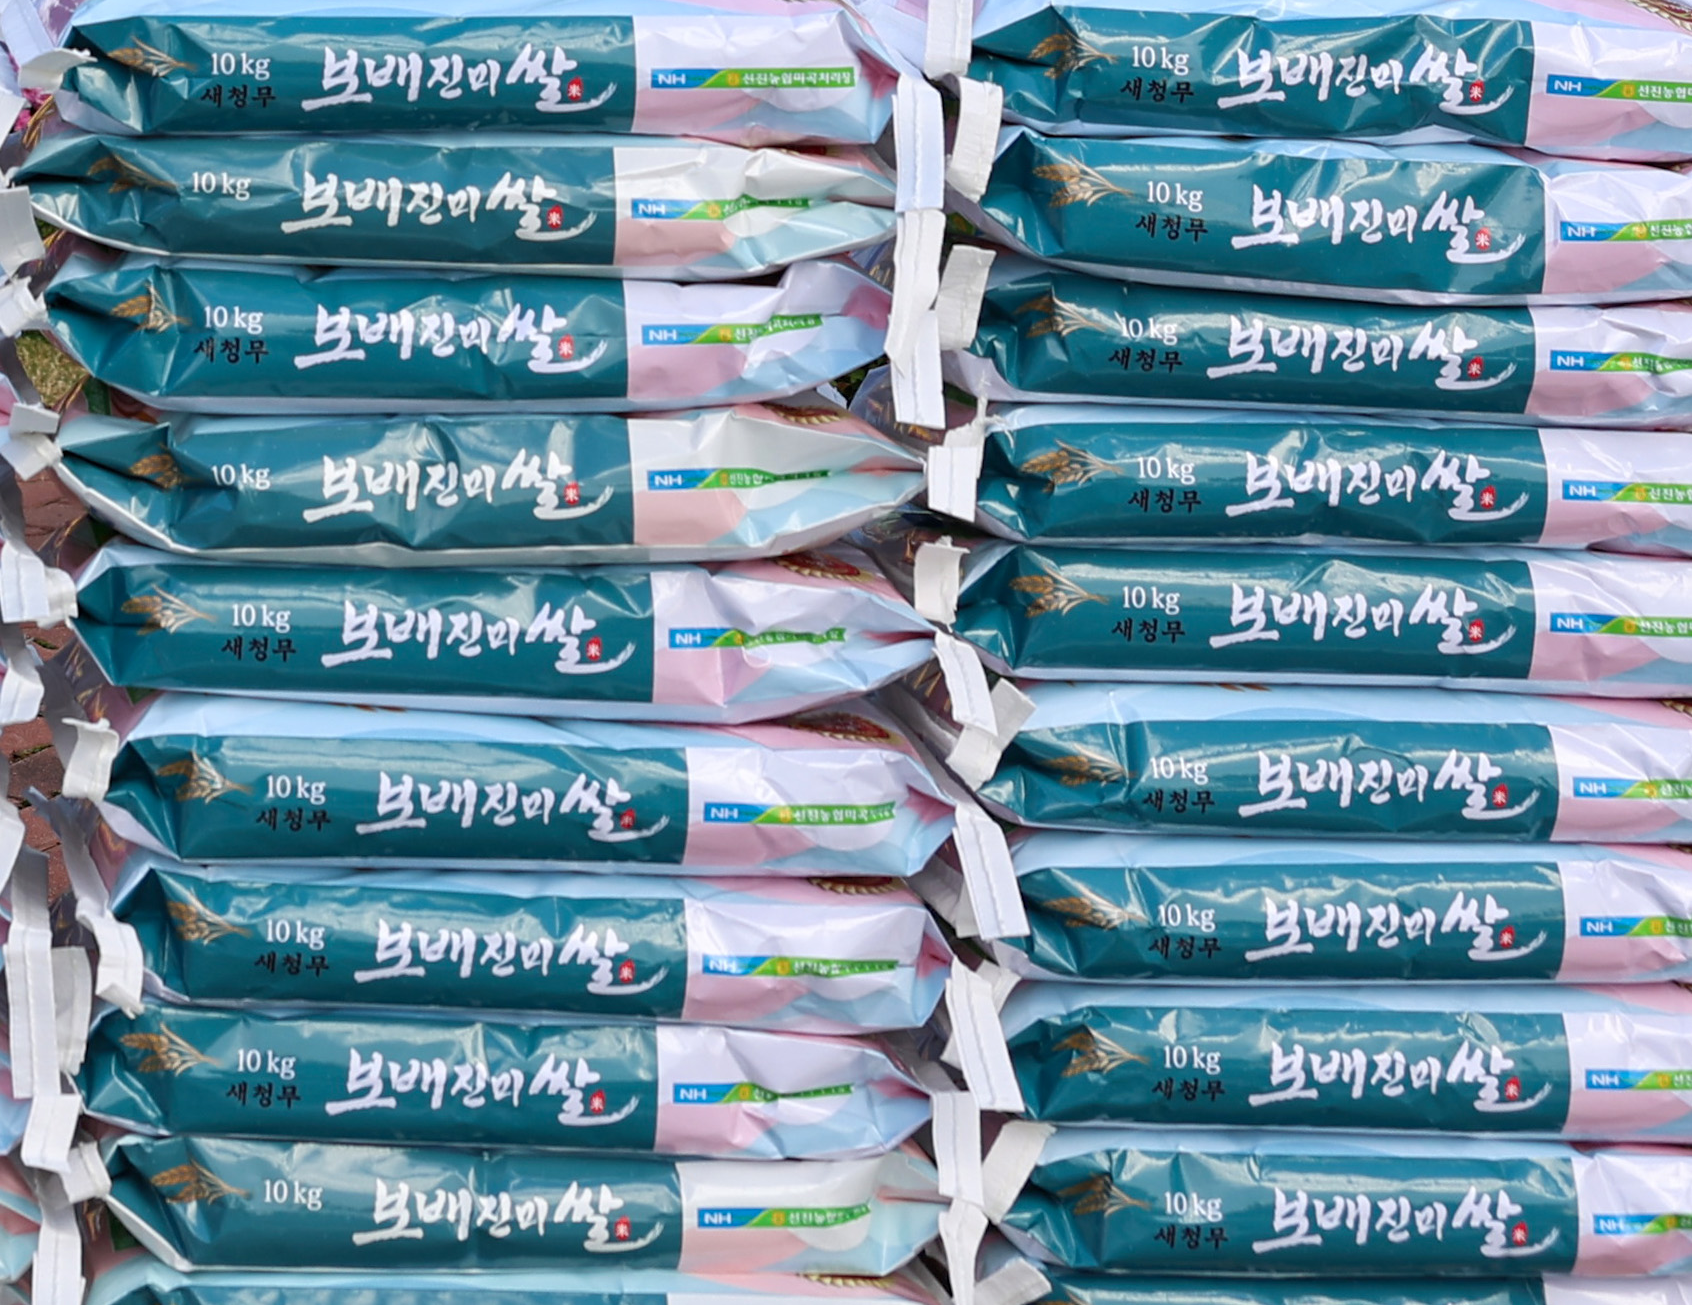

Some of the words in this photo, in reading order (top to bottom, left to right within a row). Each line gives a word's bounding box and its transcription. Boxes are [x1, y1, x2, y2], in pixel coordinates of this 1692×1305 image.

[201, 84, 276, 110] 새청무
[301, 45, 616, 112] 보배진미쌀
[658, 74, 686, 85] NH
[1121, 78, 1194, 103] 새청무
[1218, 45, 1514, 113] 보배진미쌀
[1554, 77, 1583, 93] NH
[281, 173, 595, 241] 보배진미쌀
[1135, 214, 1208, 239] 새청무
[1231, 185, 1525, 264] 보배진미쌀
[193, 338, 269, 363] 새청무
[294, 305, 605, 373] 보배진미쌀
[1207, 316, 1516, 389] 보배진미쌀
[303, 449, 613, 518] 보배진미쌀
[1226, 450, 1530, 520] 보배진미쌀
[321, 598, 634, 673] 보배진미쌀
[1210, 584, 1516, 654] 보배진미쌀
[355, 773, 668, 842] 보배진미쌀
[1239, 750, 1540, 818] 보배진미쌀
[355, 920, 666, 994] 보배진미쌀
[1245, 893, 1546, 961] 보배진미쌀
[325, 1050, 639, 1125] 보배진미쌀
[1249, 1041, 1551, 1113] 보배진미쌀
[353, 1180, 662, 1251] 보배진미쌀
[1253, 1188, 1560, 1257] 보배진미쌀
